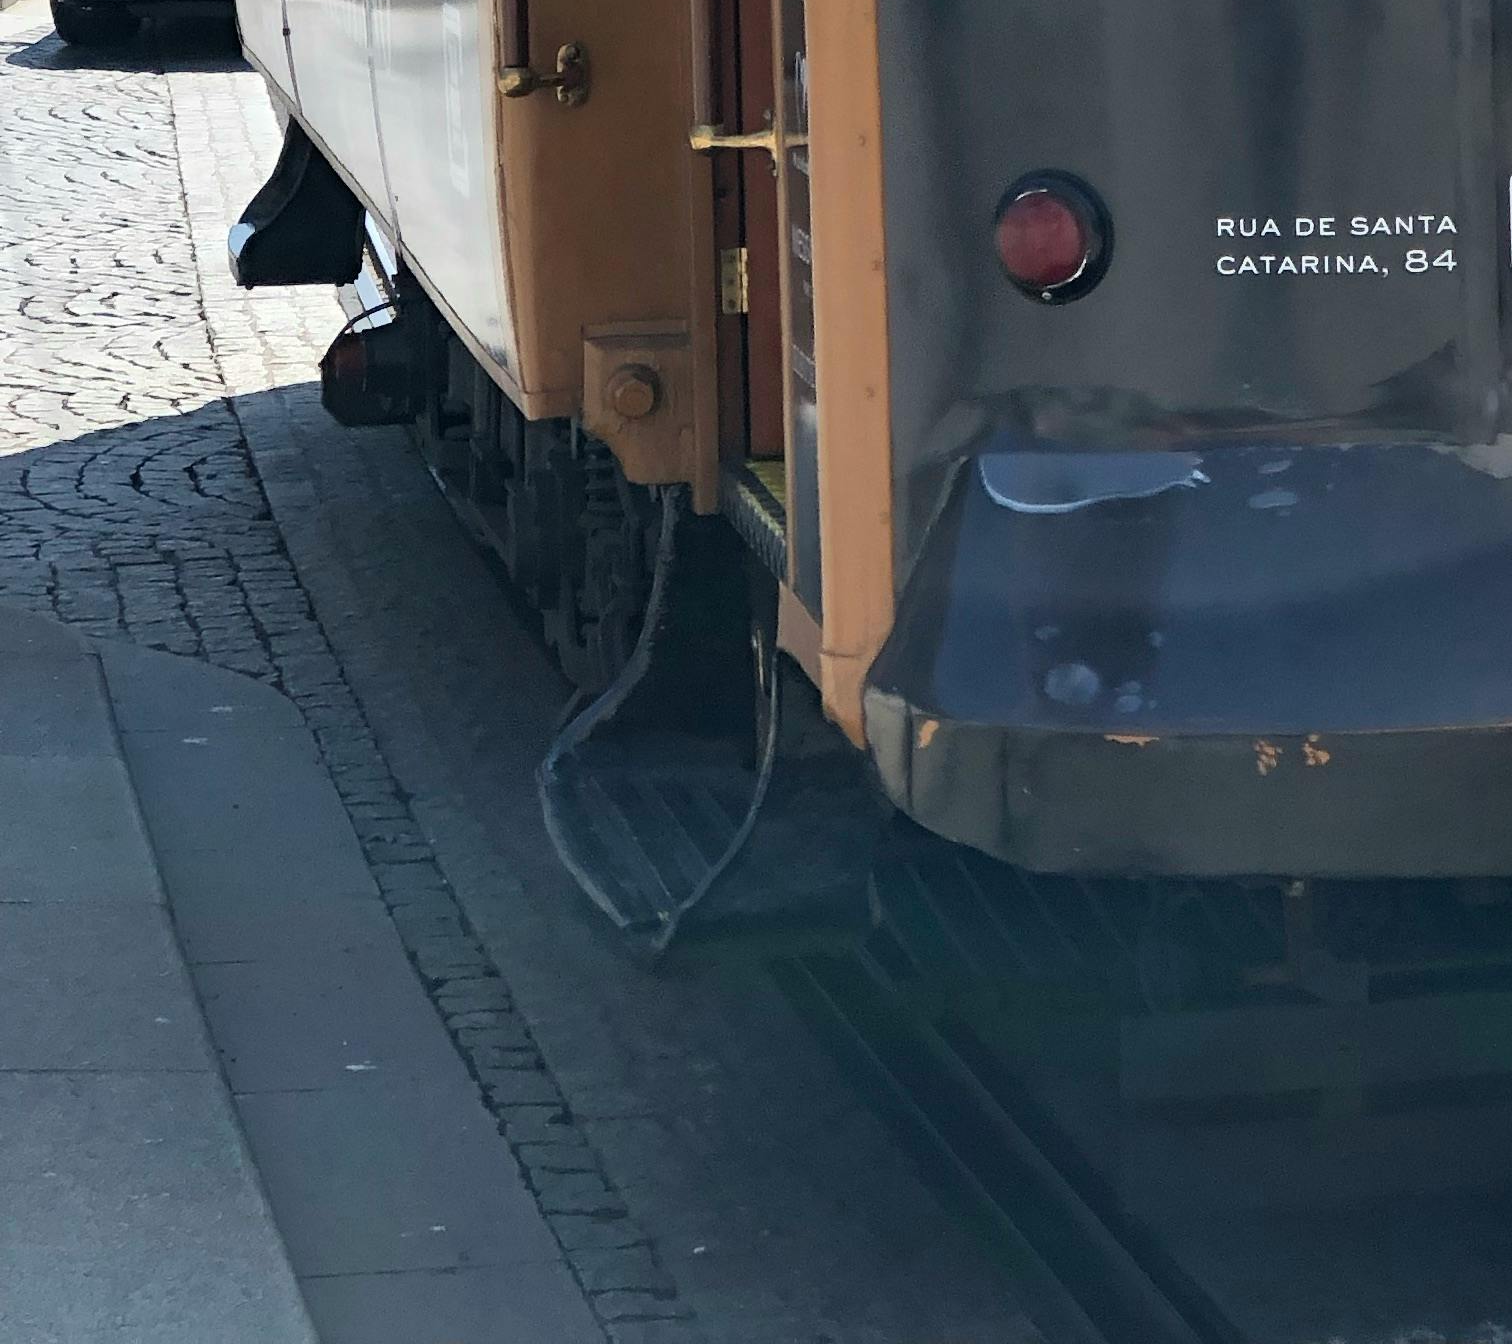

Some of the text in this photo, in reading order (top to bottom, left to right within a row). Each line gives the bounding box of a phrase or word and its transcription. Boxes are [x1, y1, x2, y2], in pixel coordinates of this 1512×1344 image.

[1217, 215, 1457, 237] RUA DE SANTA
[1216, 250, 1457, 278] CATARINA, 84
